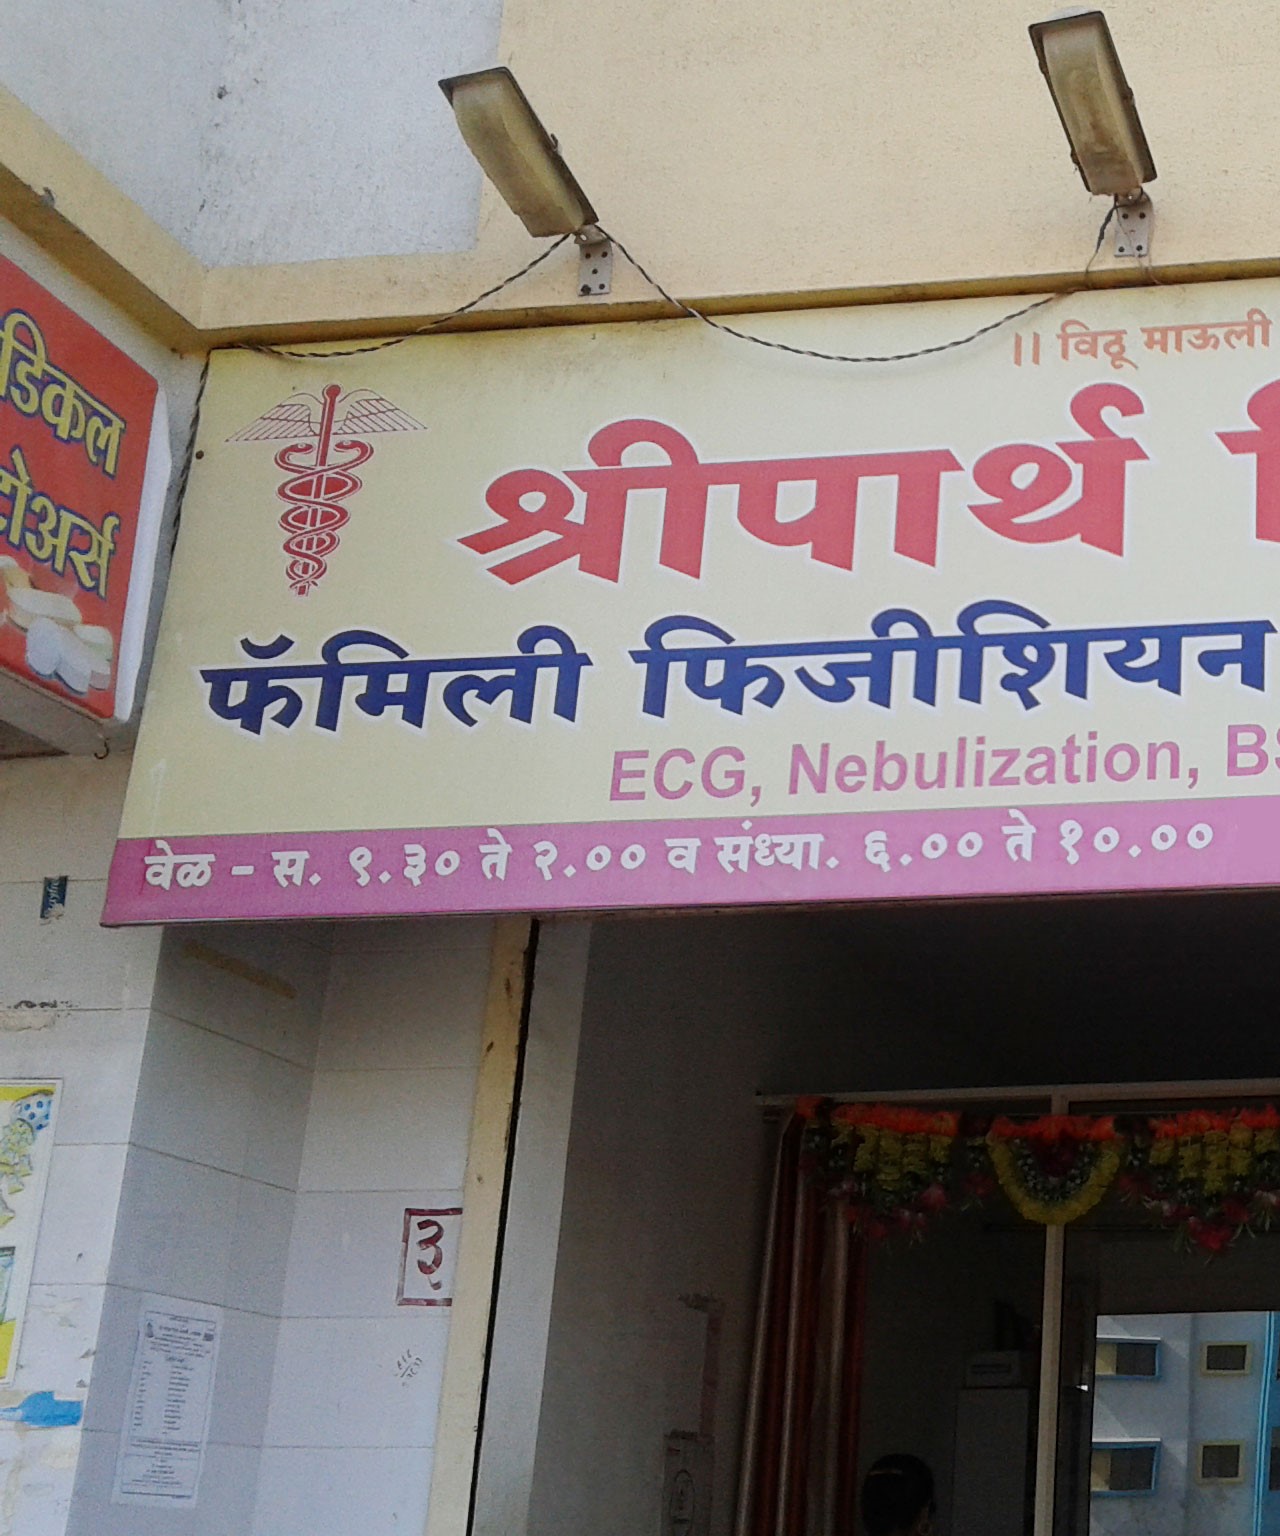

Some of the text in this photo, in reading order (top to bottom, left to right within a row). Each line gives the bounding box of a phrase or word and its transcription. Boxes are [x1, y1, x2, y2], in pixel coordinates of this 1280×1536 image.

[1056, 319, 1139, 370] विठू
[1140, 308, 1273, 354] माऊली
[456, 383, 1150, 585] श्रीपार्थ
[201, 625, 593, 735] फॅमिली
[628, 600, 1277, 721] फिजीशियन
[609, 745, 763, 807] ECG,
[788, 729, 1200, 796] Nebulization,
[145, 840, 215, 891] वेळ
[272, 850, 322, 888] स.
[350, 841, 460, 887] ९.३०
[480, 828, 512, 880] ते
[533, 839, 647, 880] २.००
[665, 837, 700, 873] व
[715, 820, 840, 873] संध्या.
[1002, 808, 1036, 861] ते
